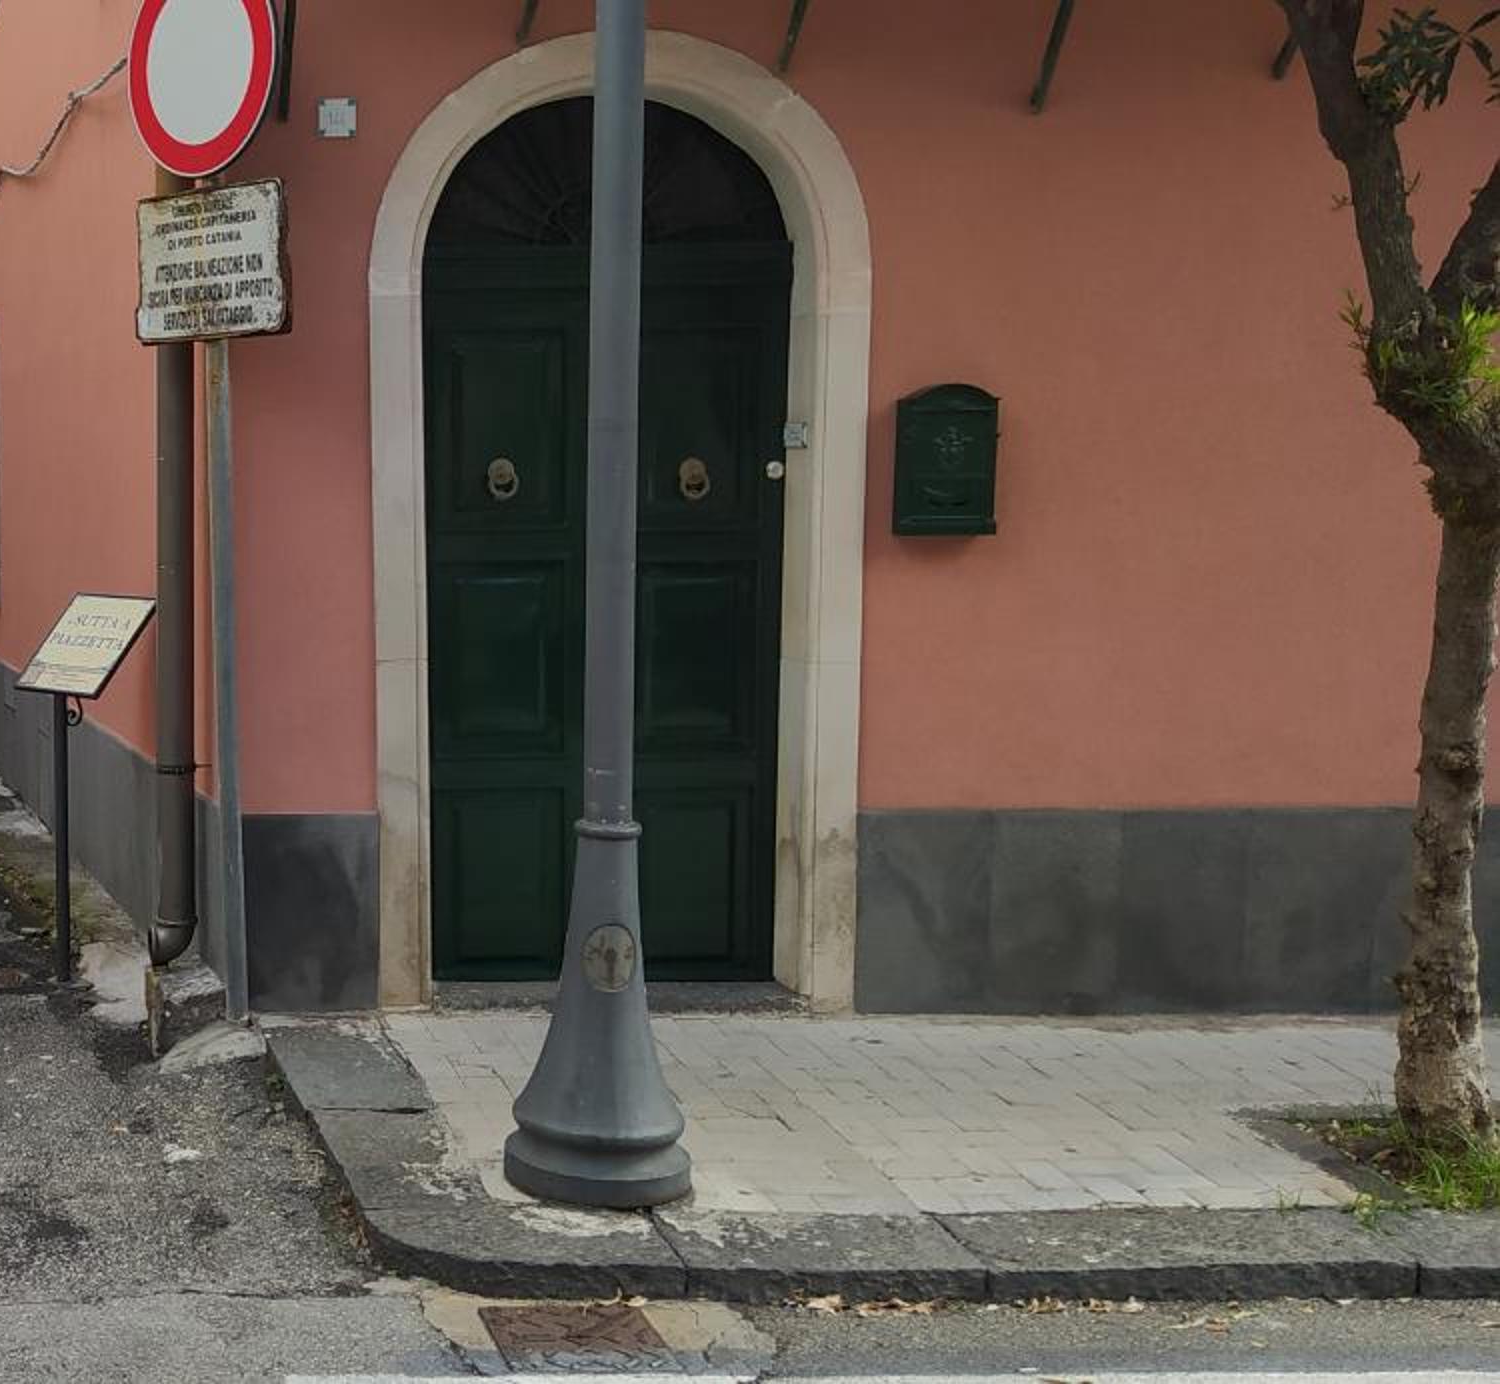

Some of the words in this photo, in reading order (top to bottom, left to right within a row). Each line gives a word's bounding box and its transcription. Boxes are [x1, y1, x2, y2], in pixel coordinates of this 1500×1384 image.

[155, 219, 197, 236] ORDINANZA
[201, 209, 256, 228] CAPITANERIA
[168, 239, 176, 250] DI
[178, 235, 203, 249] PORTO
[206, 230, 242, 245] CATANIA
[155, 262, 192, 284] ATTENZIONE
[194, 255, 244, 279] BALNEAZIONE
[246, 253, 262, 271] NON
[170, 288, 182, 306] PER
[184, 283, 223, 305] MANCANZA
[236, 277, 274, 300] APPOSITO
[49, 631, 124, 650] PIAZZETTA
